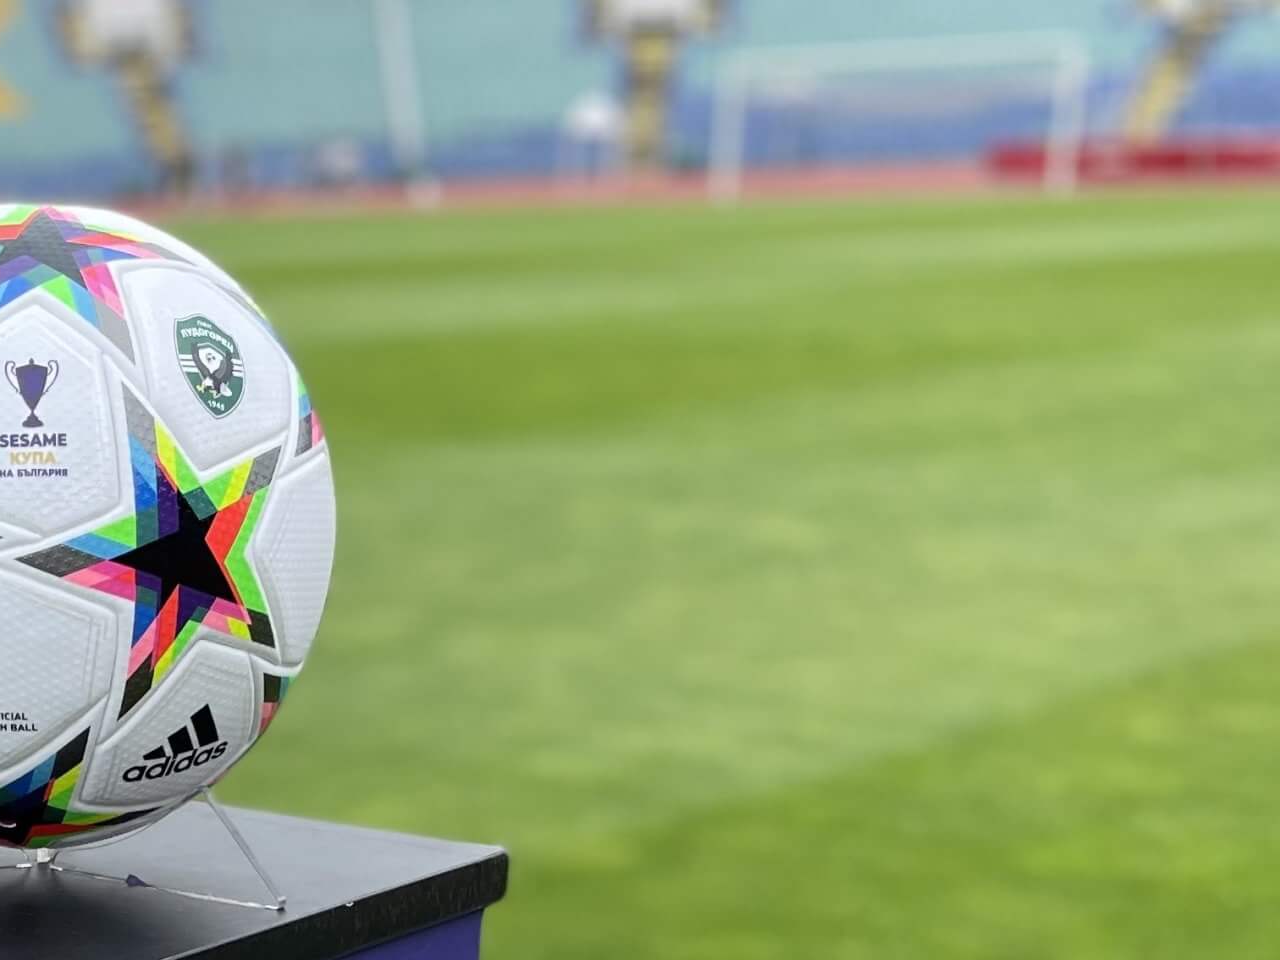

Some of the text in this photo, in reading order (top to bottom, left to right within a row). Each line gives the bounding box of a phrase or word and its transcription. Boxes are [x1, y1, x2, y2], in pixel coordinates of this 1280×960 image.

[0, 433, 68, 448] SESAME
[9, 451, 57, 465] КУПА
[0, 468, 68, 478] НА БЪЛГАРИЯ
[10, 723, 38, 732] BALL
[122, 741, 228, 783] adidas
